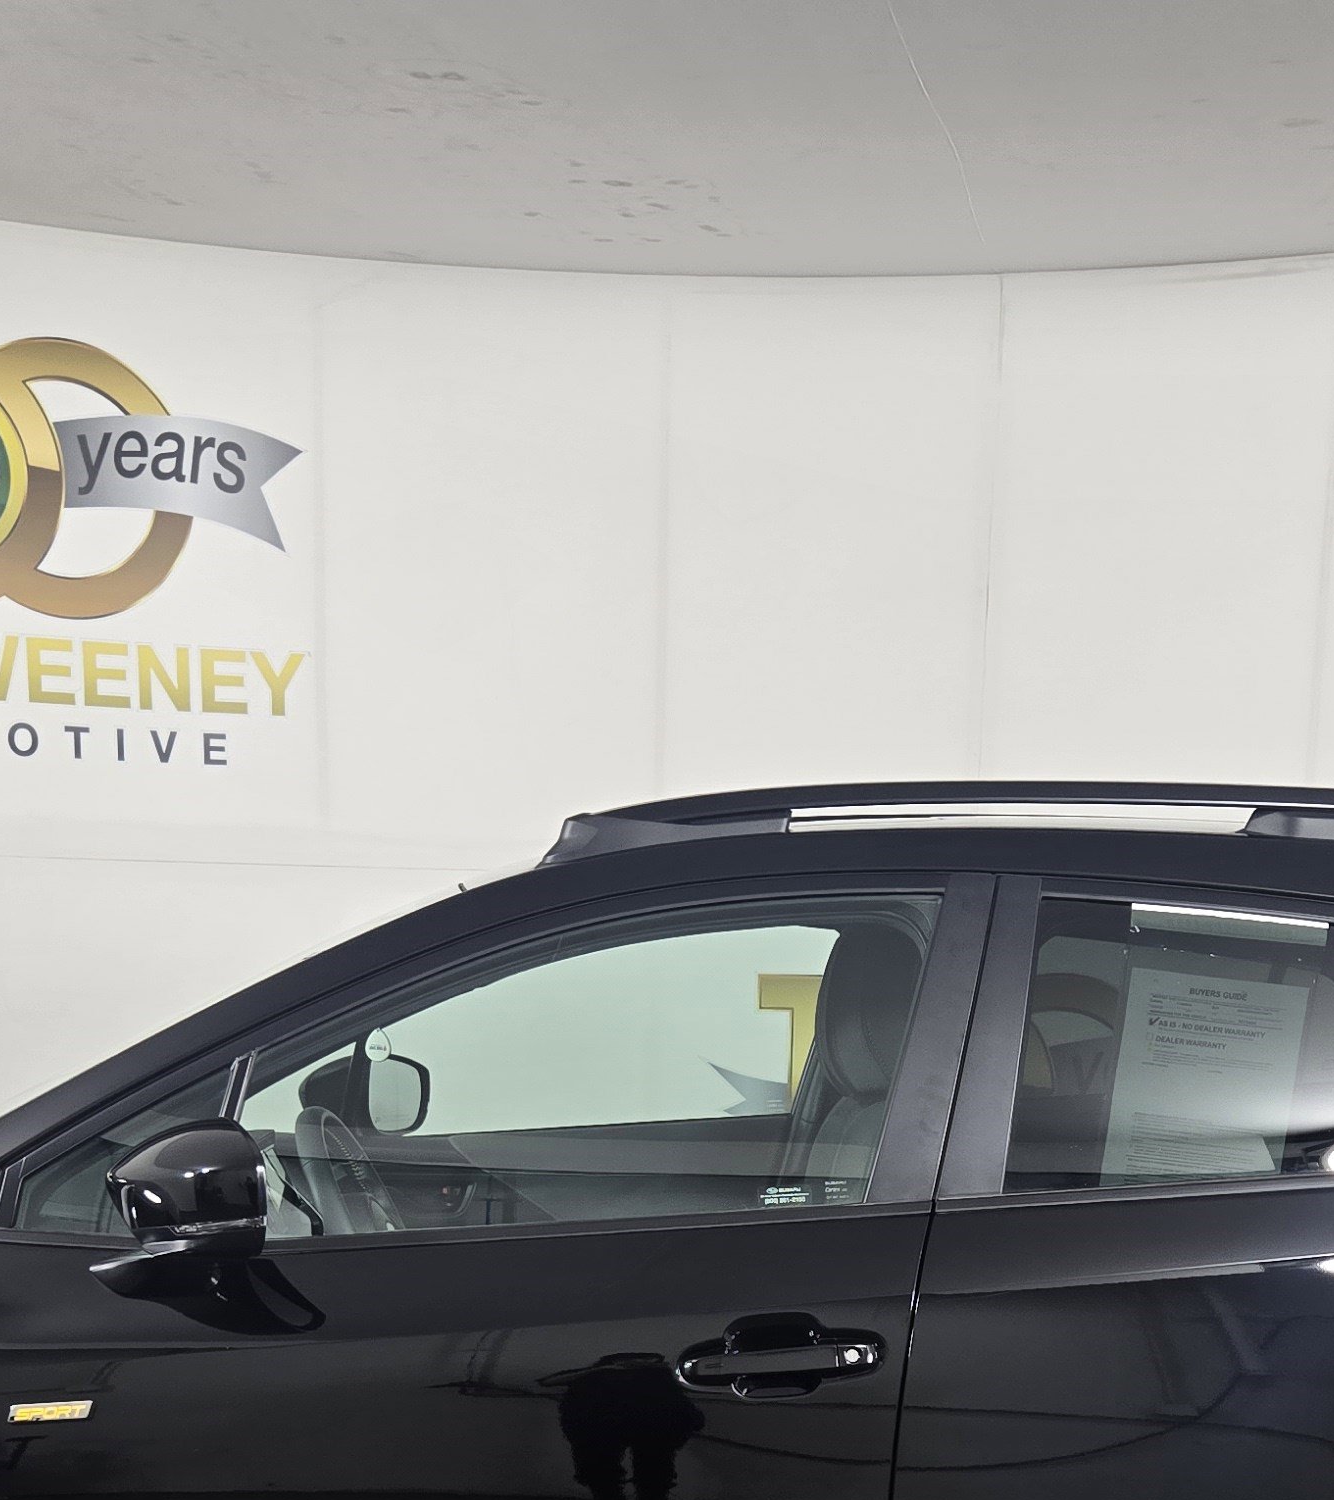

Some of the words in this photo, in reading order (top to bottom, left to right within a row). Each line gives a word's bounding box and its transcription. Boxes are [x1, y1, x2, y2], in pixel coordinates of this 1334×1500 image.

[76, 428, 248, 496] years
[1189, 987, 1221, 998] BUYERS
[1223, 991, 1248, 1001] GUIDE
[1194, 1024, 1223, 1034] DEALER
[1224, 1028, 1266, 1039] WARRANTY
[1155, 1035, 1184, 1045] DEALER
[1186, 1039, 1227, 1050] WARRANTY
[13, 1404, 86, 1421] SPORT
